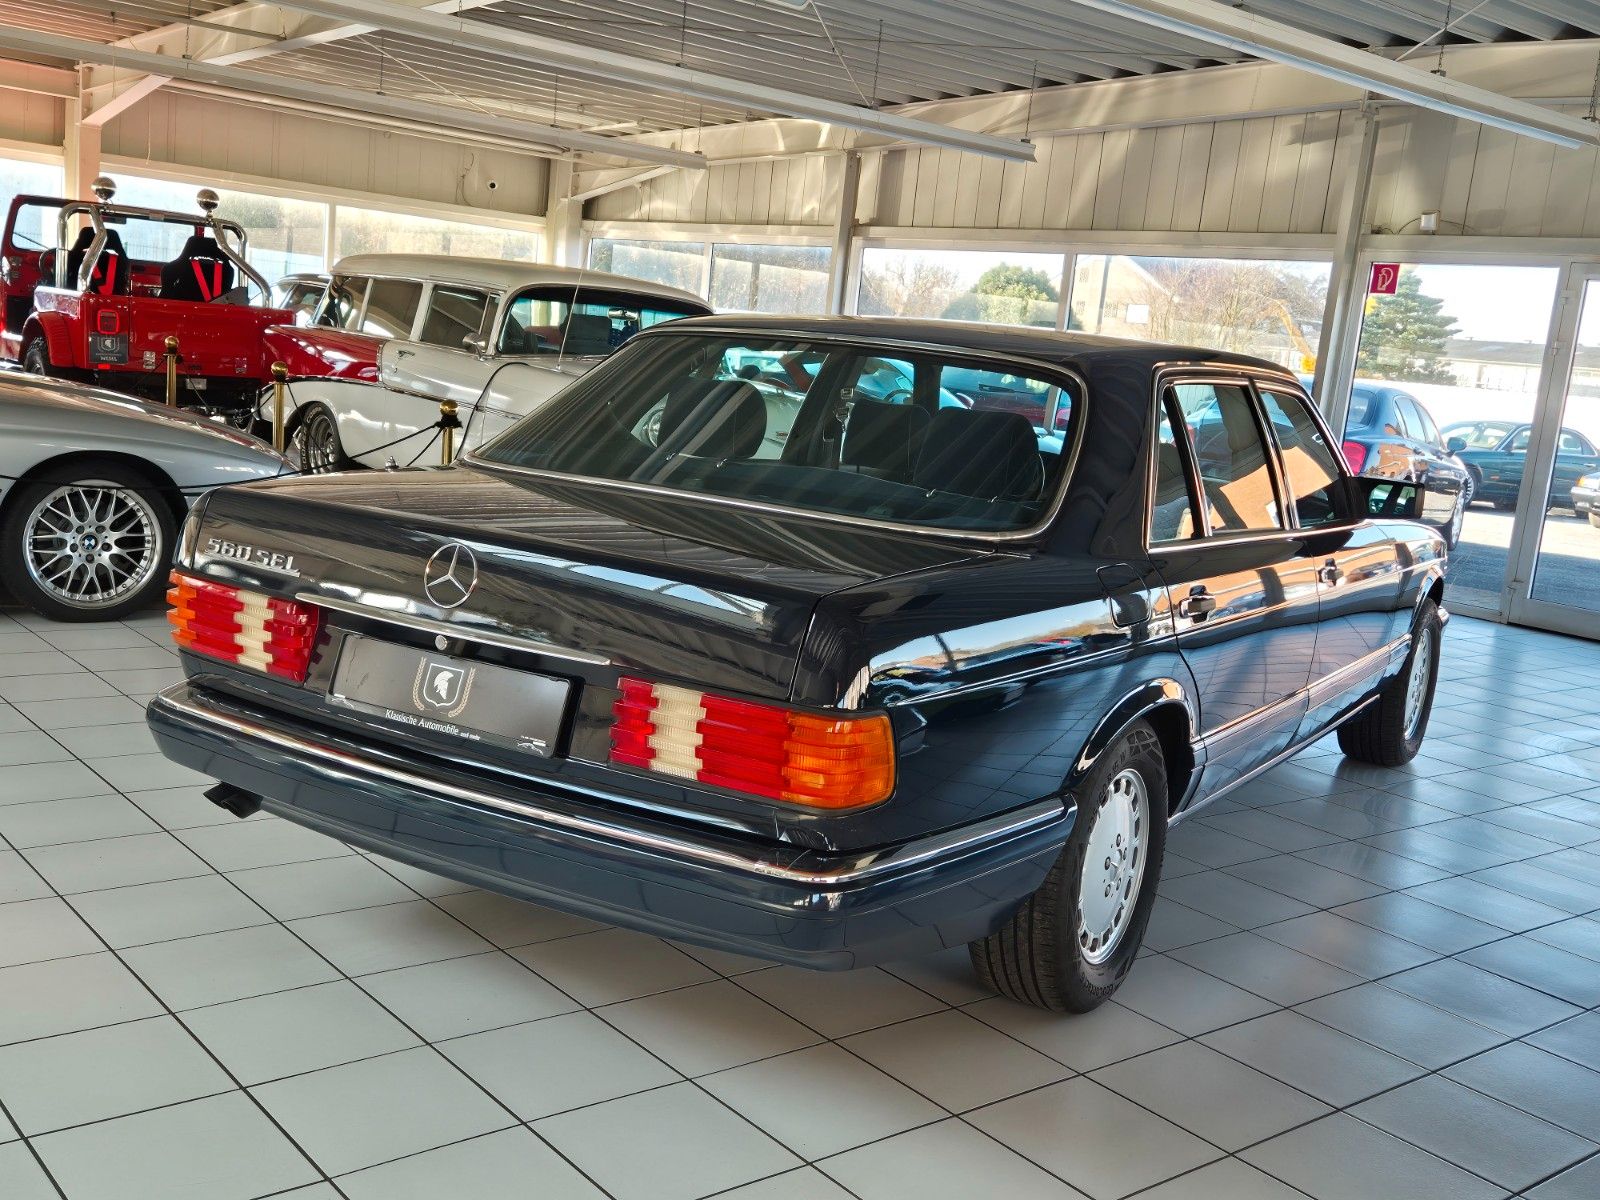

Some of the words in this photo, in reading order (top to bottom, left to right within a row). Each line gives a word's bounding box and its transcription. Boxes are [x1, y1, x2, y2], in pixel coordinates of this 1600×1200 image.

[204, 538, 252, 561] 560
[256, 549, 300, 573] SEL
[385, 709, 417, 726] Klassische
[418, 718, 459, 736] Automobile
